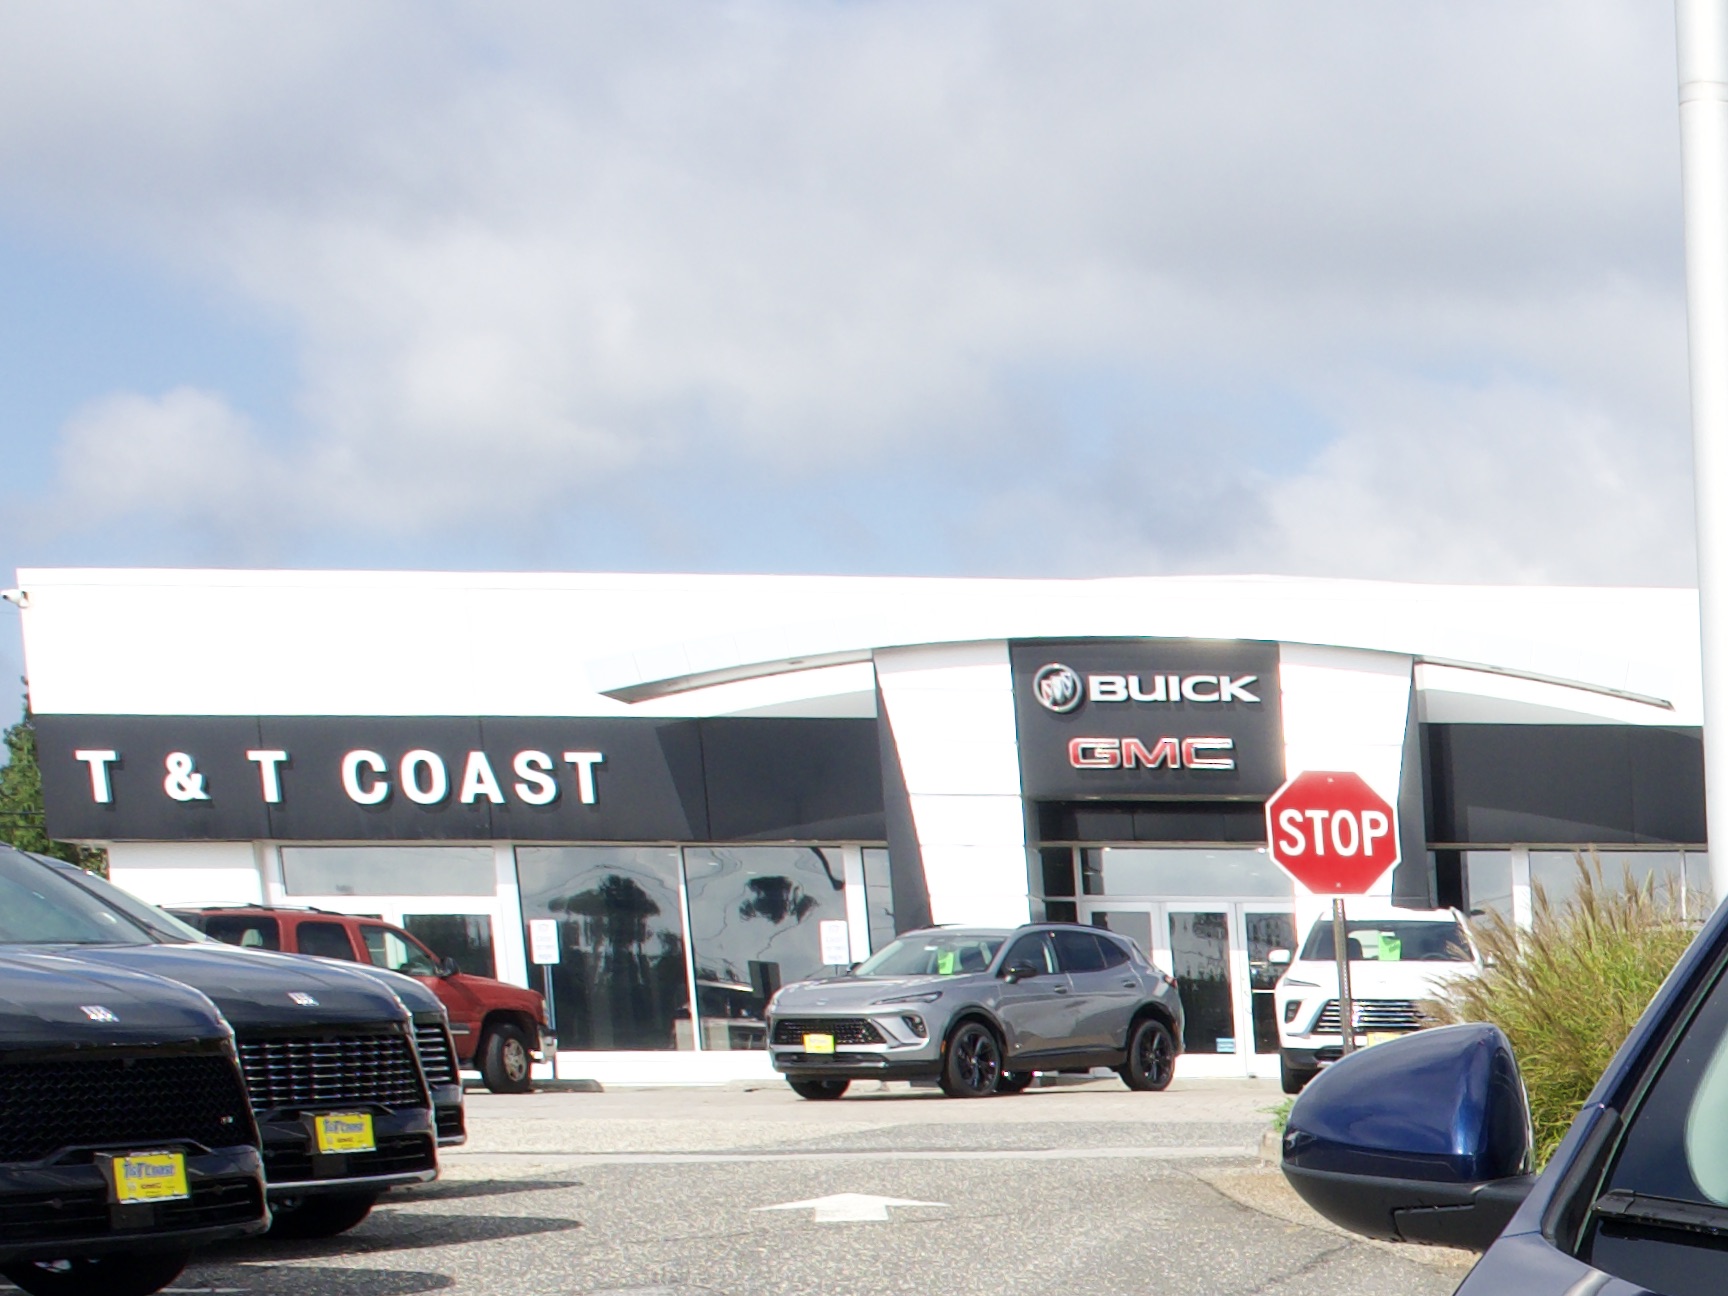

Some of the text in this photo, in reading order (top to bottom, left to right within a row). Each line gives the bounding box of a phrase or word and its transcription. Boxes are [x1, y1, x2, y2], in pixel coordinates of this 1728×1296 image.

[1088, 675, 1260, 703] BUICK
[1068, 736, 1235, 770] GMC
[74, 749, 603, 806] T & T COAST
[1278, 808, 1389, 857] STOP
